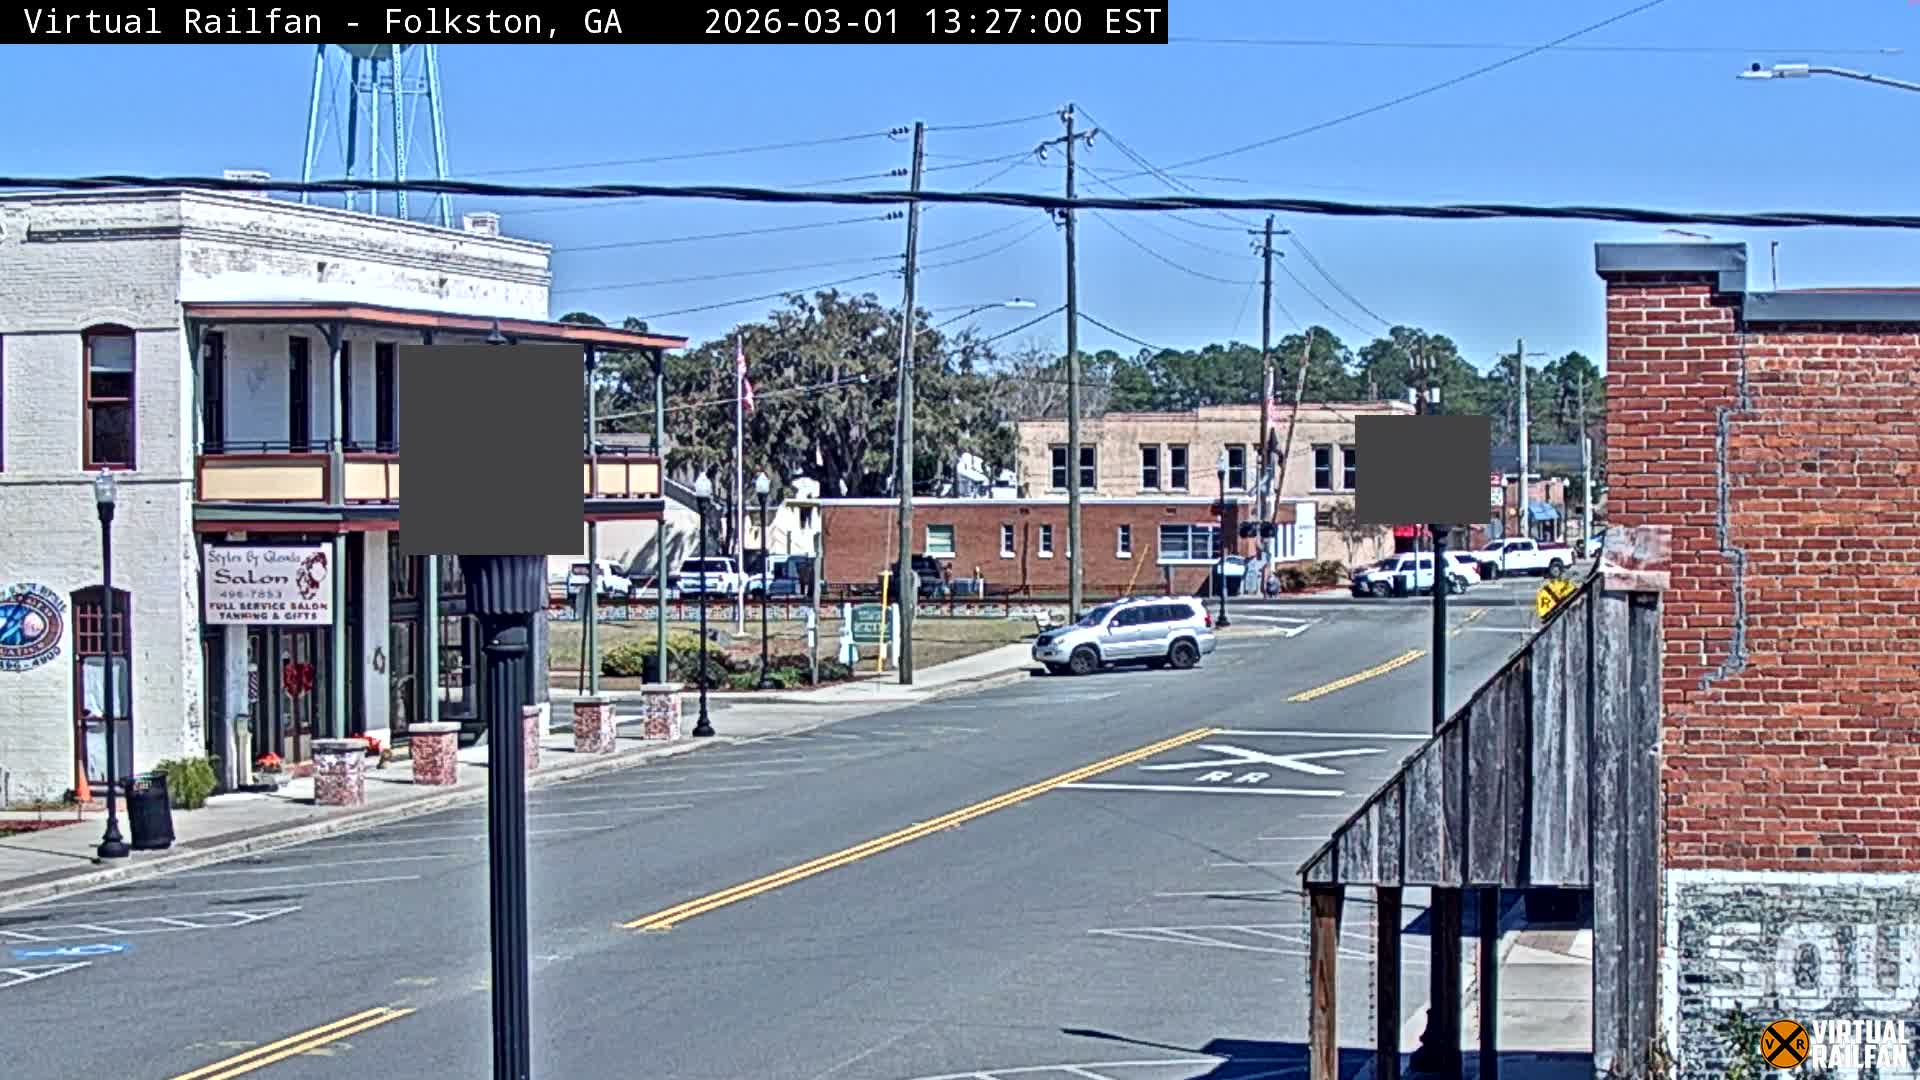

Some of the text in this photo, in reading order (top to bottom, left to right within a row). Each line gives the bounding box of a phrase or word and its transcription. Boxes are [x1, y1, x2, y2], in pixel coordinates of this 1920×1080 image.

[208, 550, 242, 567] Styles
[246, 550, 260, 567] By
[214, 569, 289, 584] Salon
[208, 602, 329, 610] FULL SERVICE SALON
[219, 612, 318, 620] TANNING & GIFTS
